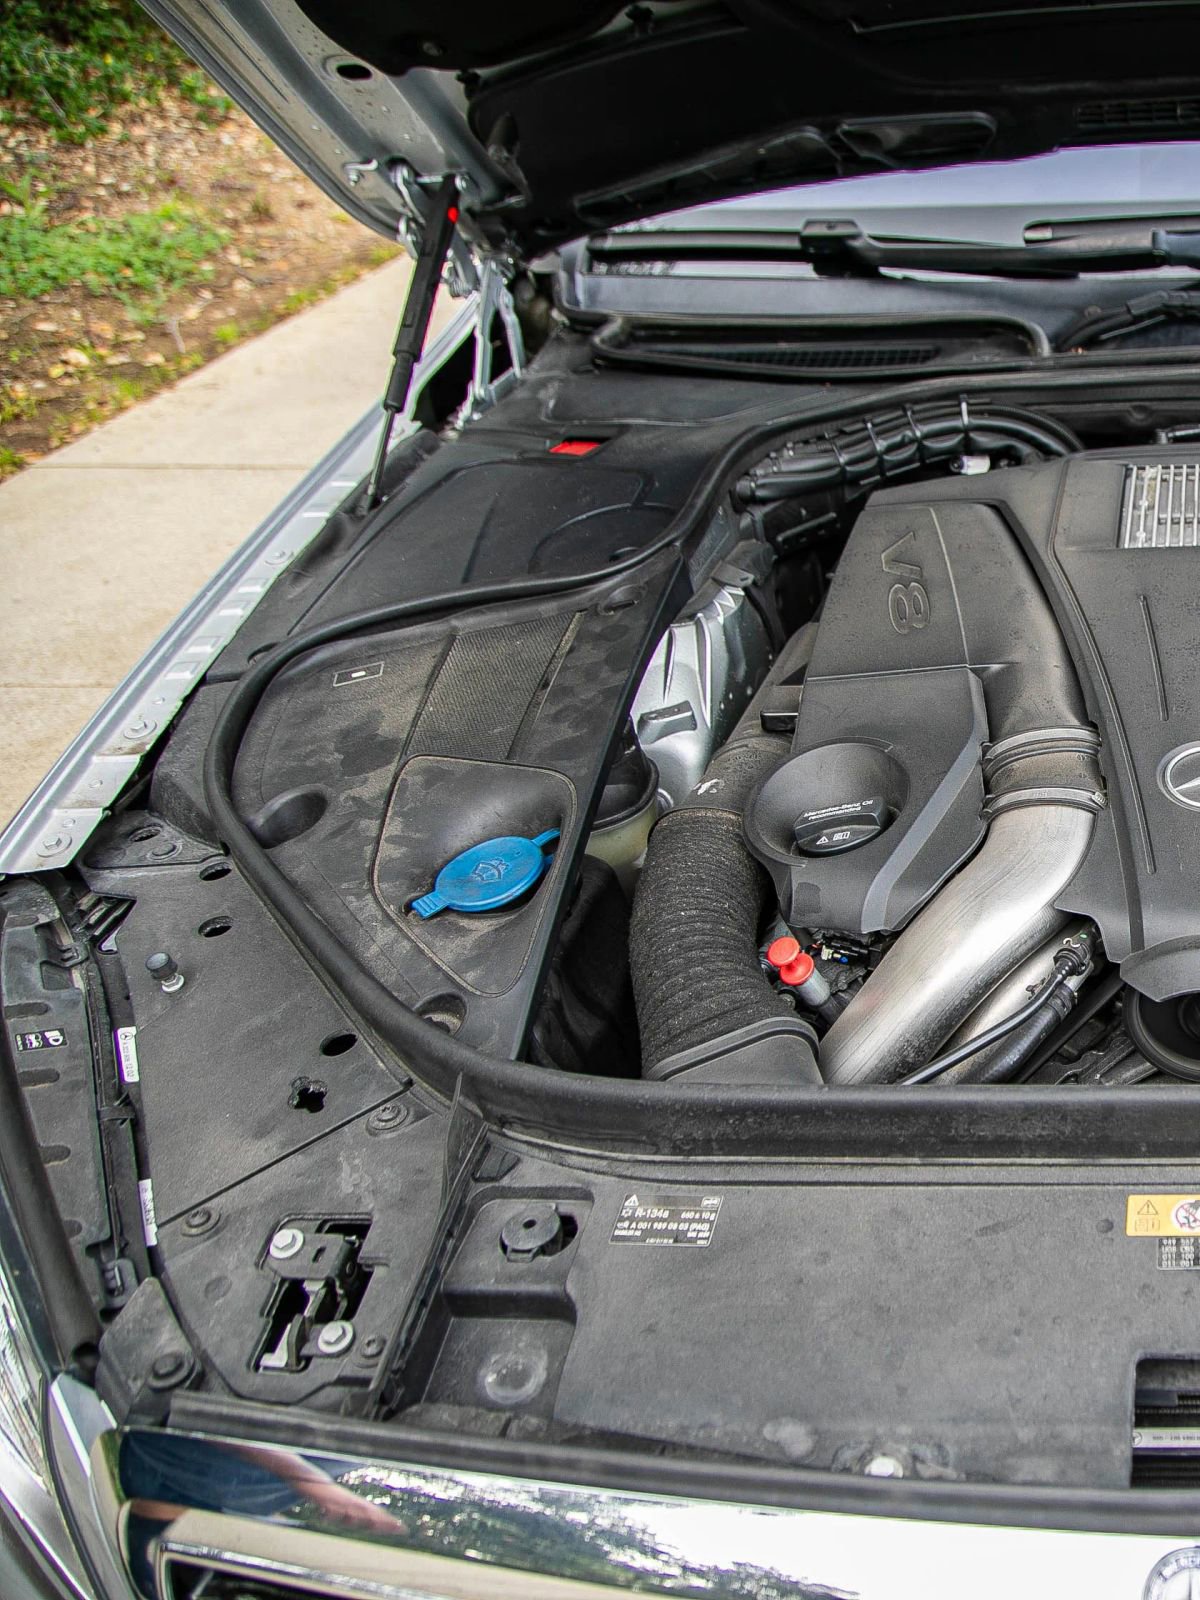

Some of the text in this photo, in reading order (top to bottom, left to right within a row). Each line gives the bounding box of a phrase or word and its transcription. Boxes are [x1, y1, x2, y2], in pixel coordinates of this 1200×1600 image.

[881, 530, 931, 635] V8
[803, 802, 861, 818] Mercedes-Benz
[808, 806, 862, 821] recommended
